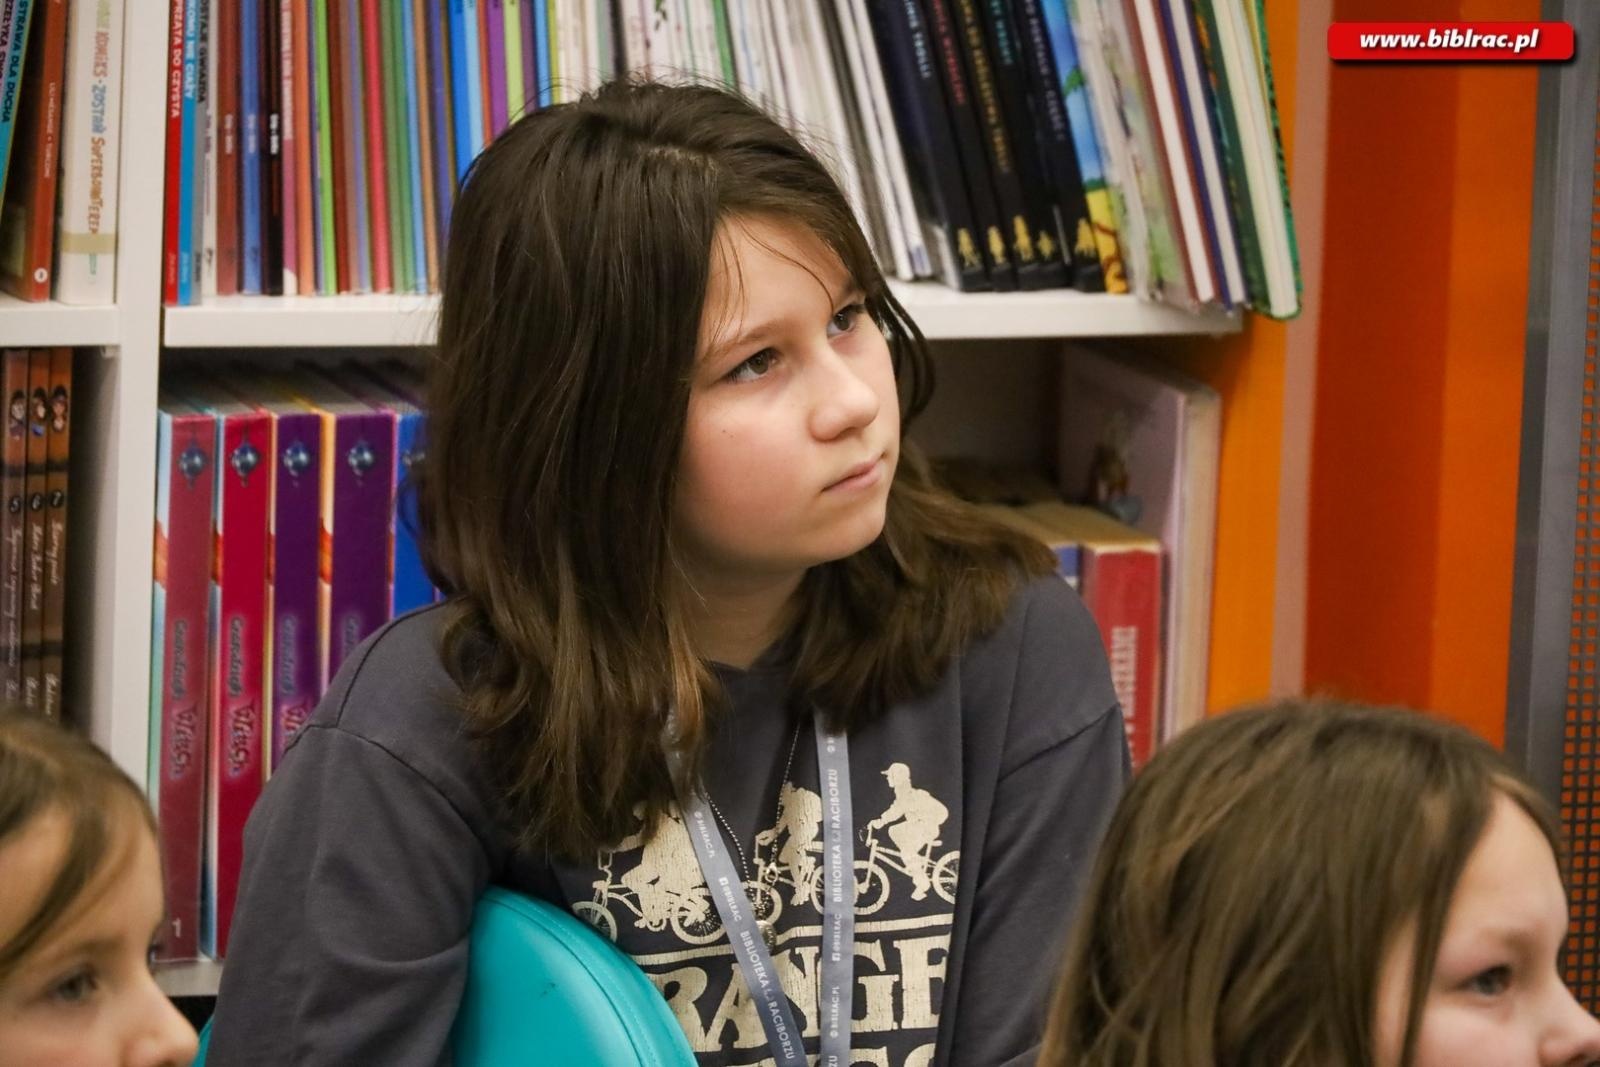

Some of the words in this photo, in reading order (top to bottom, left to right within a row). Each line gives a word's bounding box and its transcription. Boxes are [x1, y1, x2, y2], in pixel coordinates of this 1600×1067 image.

[13, 0, 28, 51] STRAWA
[9, 55, 20, 77] DLA
[173, 48, 182, 66] DO
[2, 81, 15, 123] DUCHA
[170, 69, 182, 118] CZYSTA
[826, 767, 840, 834] RACIBORZU
[831, 843, 844, 904] BIBLIOTEKA
[172, 918, 182, 937] 1
[739, 930, 769, 989] BIBLIOTEKA
[767, 1000, 796, 1061] RACIBORZU
